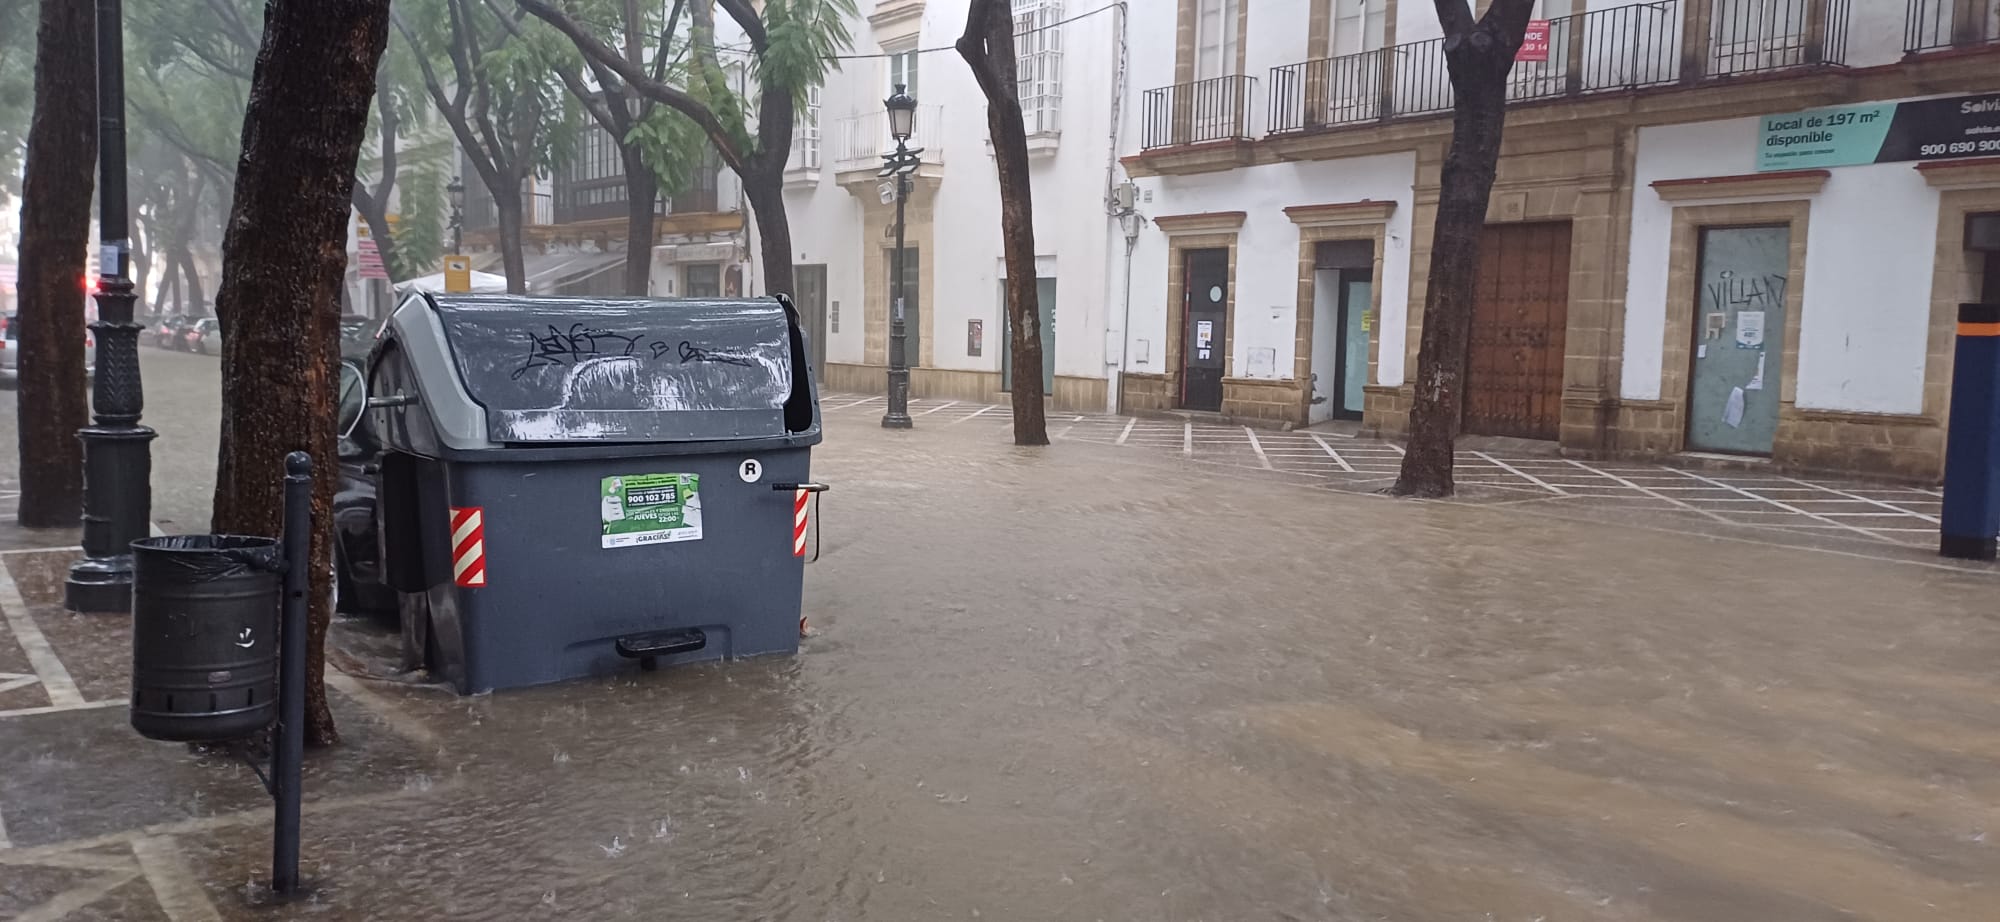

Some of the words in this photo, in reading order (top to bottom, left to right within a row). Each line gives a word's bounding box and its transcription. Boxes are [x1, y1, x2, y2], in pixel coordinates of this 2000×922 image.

[1524, 32, 1543, 40] NDE
[1960, 98, 2000, 113] Solvi
[1768, 118, 1802, 131] Local
[1806, 116, 1822, 128] de
[1826, 112, 1856, 127] 197
[1766, 131, 1833, 147] disponible
[1920, 143, 1946, 155] 900
[1949, 141, 1975, 153] 690
[745, 462, 756, 475] R
[628, 495, 644, 503] 900
[645, 493, 660, 502] 102
[634, 512, 657, 520] JUEVES
